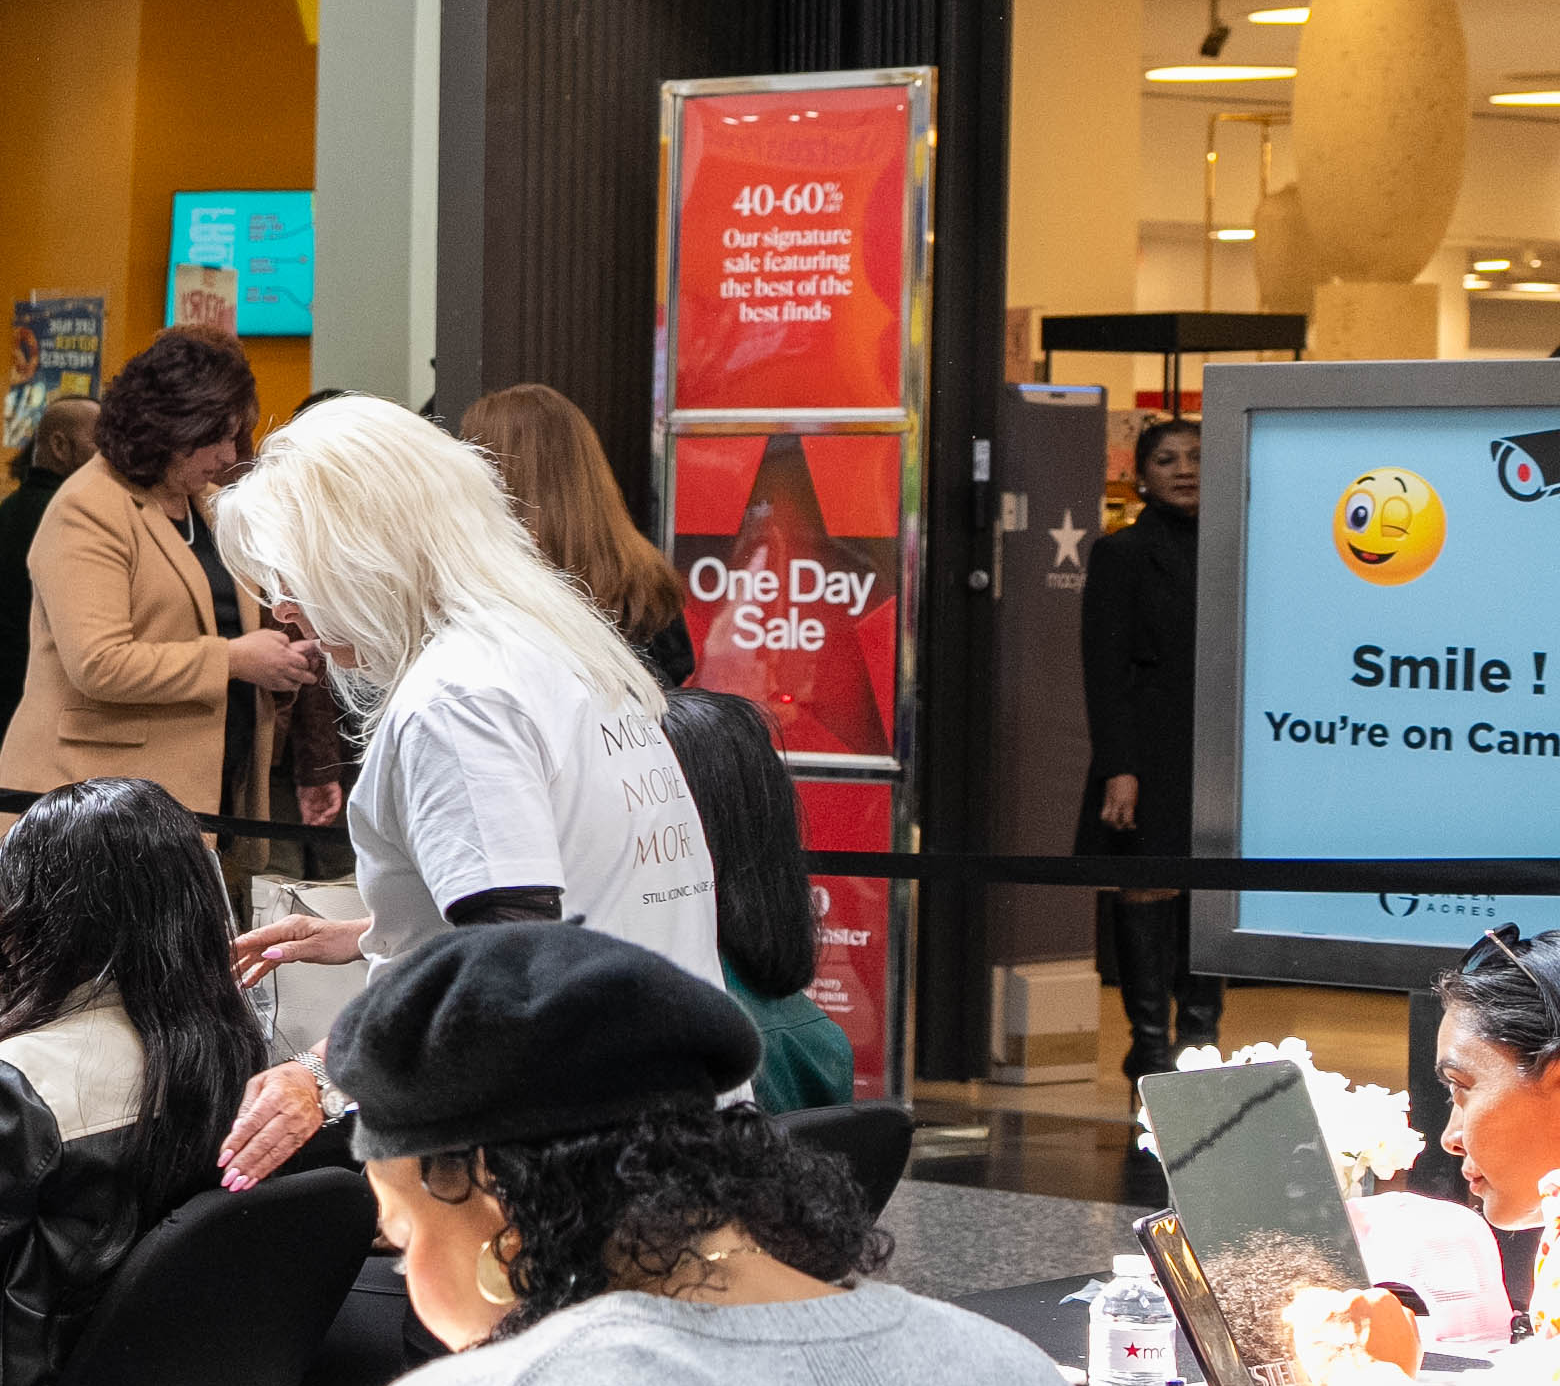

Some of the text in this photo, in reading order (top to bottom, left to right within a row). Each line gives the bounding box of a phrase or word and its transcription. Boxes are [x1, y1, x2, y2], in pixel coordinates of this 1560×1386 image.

[722, 226, 853, 252] Our signature
[723, 249, 852, 275] sale featuring
[720, 274, 854, 299] the best of the
[738, 299, 833, 322] best finds
[688, 556, 877, 616] One Day
[731, 604, 826, 652] Sale
[1350, 643, 1513, 695] Smile
[1264, 711, 1389, 750] You're
[1402, 724, 1453, 752] on
[622, 765, 686, 813] MORE
[633, 822, 695, 869] MORE
[642, 890, 667, 905] STILL
[1426, 902, 1496, 918] ACRES
